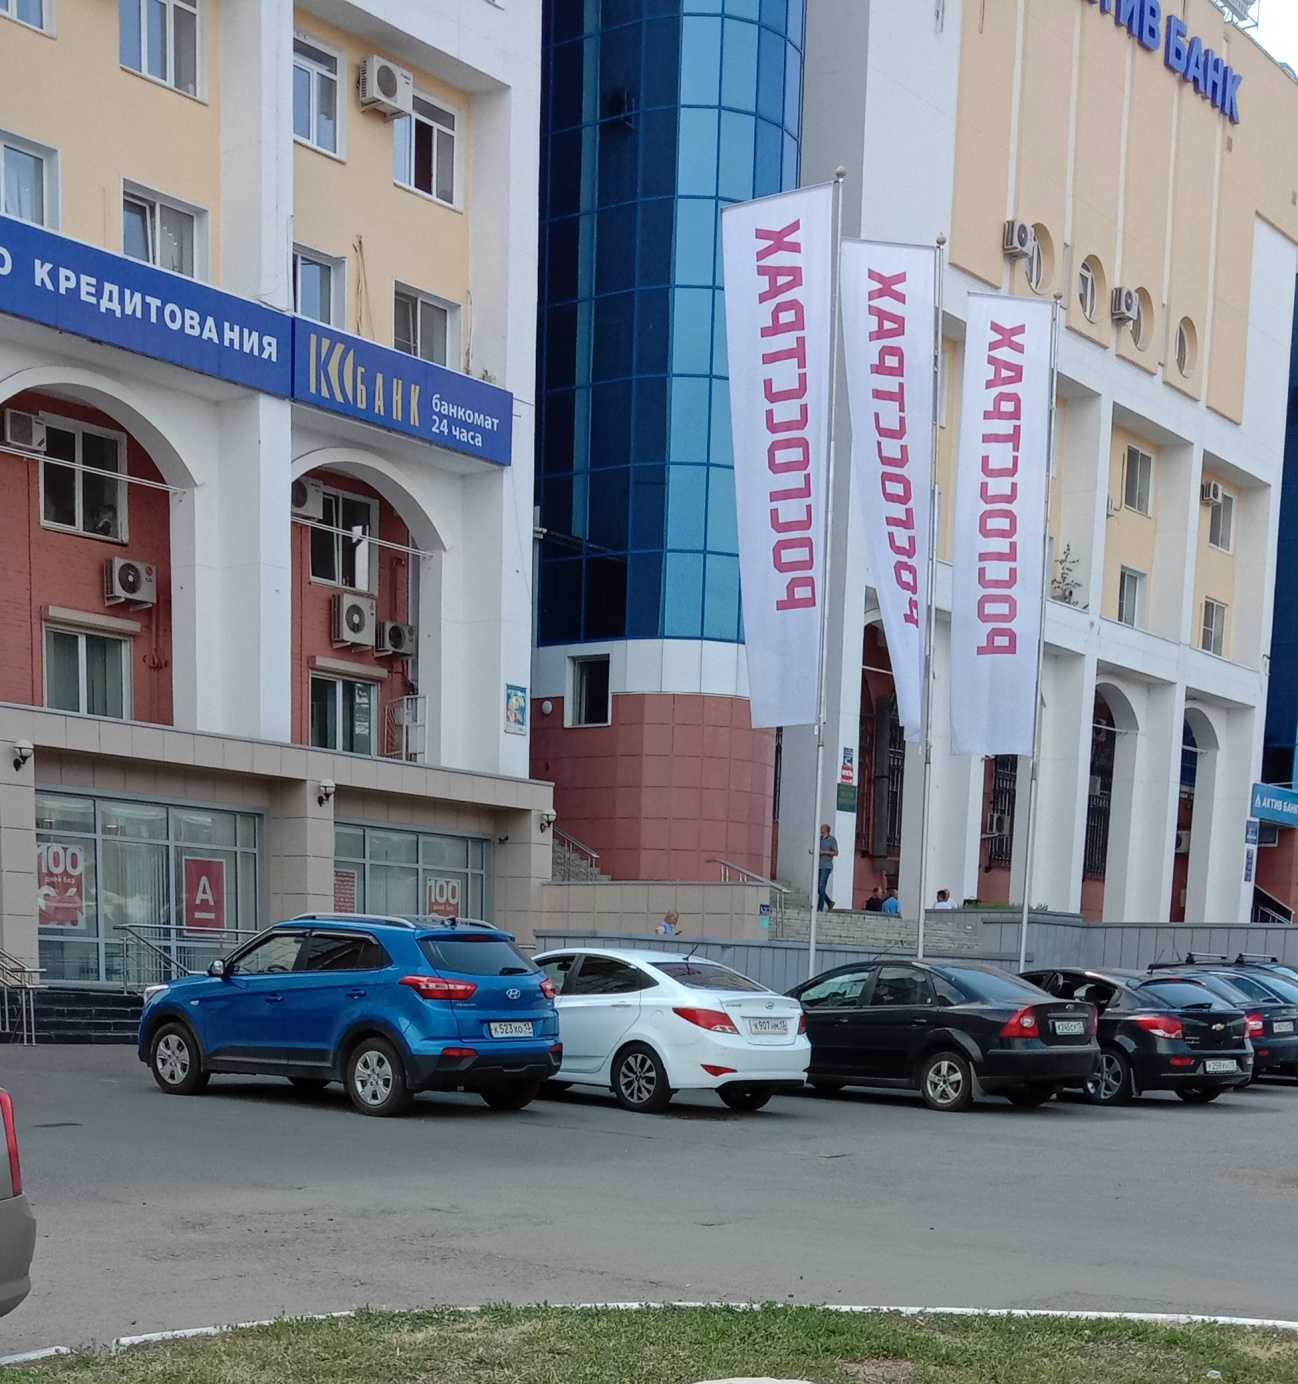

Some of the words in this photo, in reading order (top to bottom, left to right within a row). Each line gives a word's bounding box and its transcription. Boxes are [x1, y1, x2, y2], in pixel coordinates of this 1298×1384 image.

[1164, 15, 1243, 124] БАНК
[34, 258, 279, 363] КРЕДИТОВАНИЯ
[432, 394, 500, 432] банкомат
[431, 415, 449, 436] 24
[452, 425, 483, 447] часа
[38, 844, 83, 876] 100
[427, 879, 459, 905] 100
